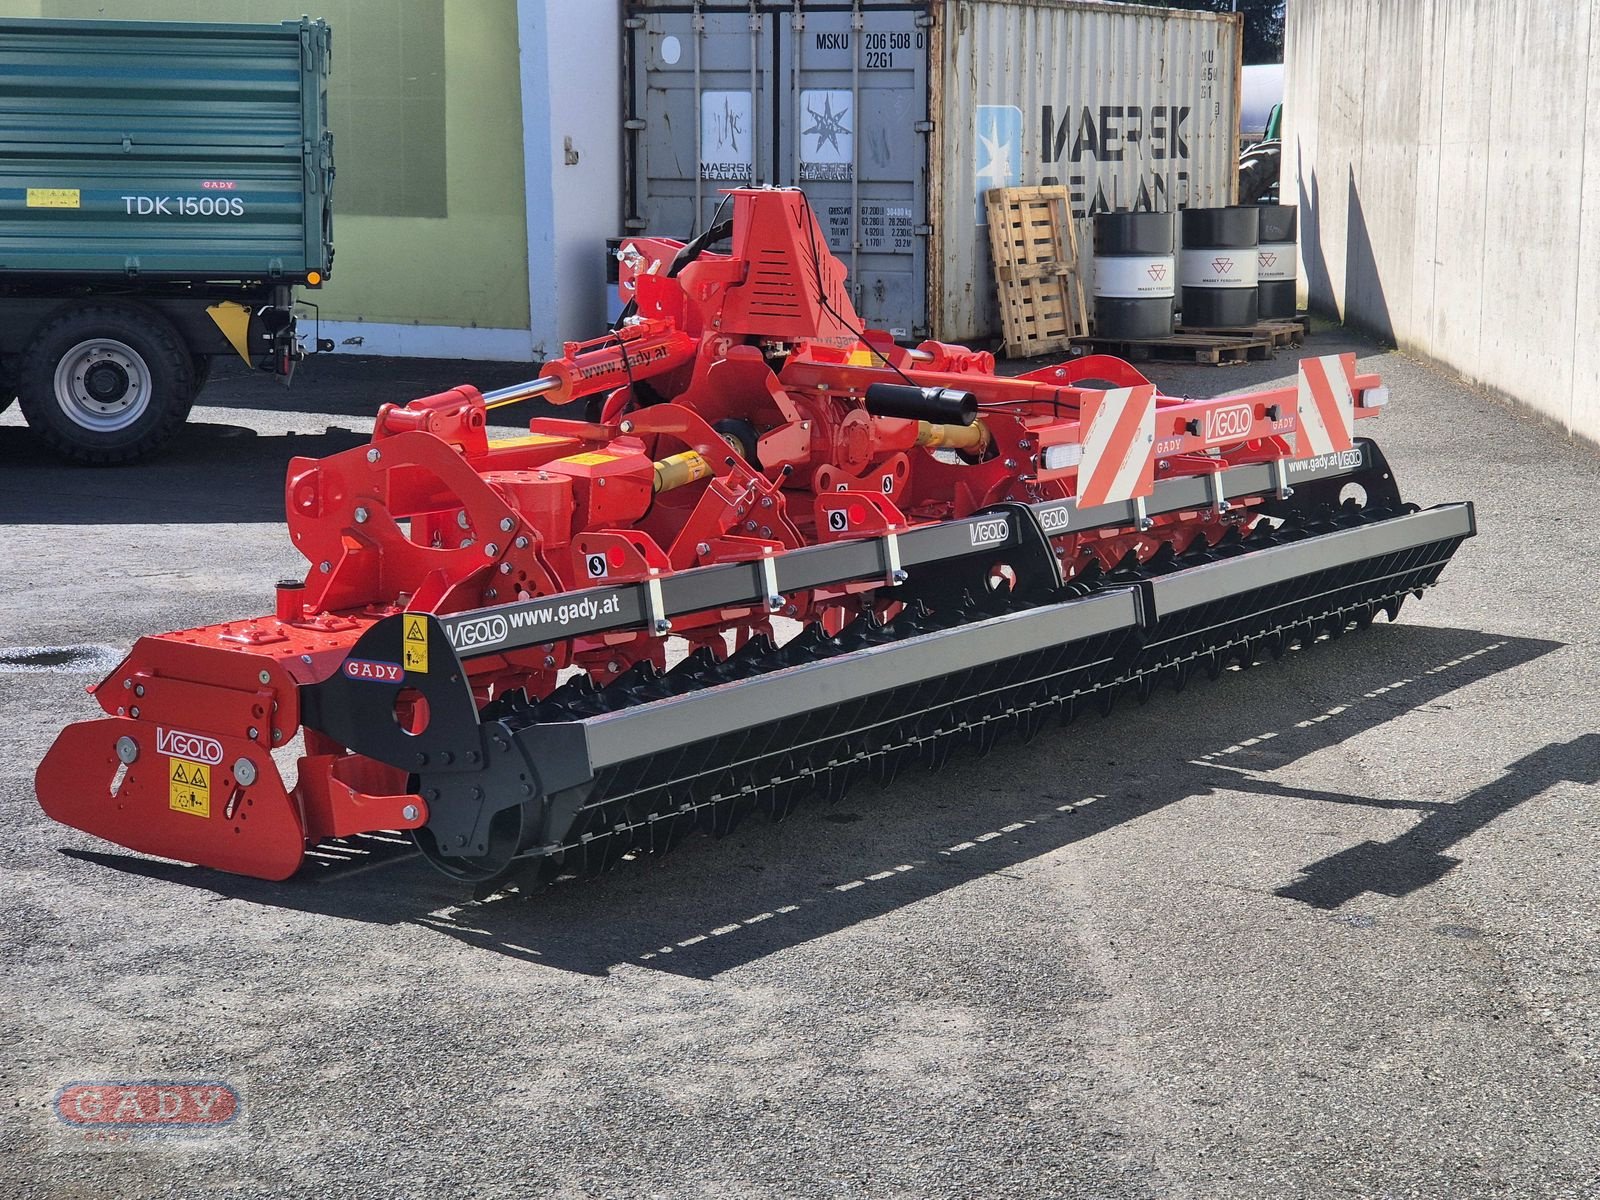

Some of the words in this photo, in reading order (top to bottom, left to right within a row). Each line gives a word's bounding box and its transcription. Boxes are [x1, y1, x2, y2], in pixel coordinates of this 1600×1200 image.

[816, 33, 849, 50] MSKU
[865, 33, 887, 50] 206
[890, 33, 911, 50] 508
[916, 32, 923, 49] 0
[866, 52, 893, 68] 22G1
[1041, 104, 1191, 163] MAERSK
[700, 162, 753, 173] MAERSK
[203, 181, 233, 190] GADY
[1041, 172, 1190, 219] EALAND
[121, 196, 173, 216] TDK
[177, 197, 245, 216] 1500S
[582, 344, 668, 379] www.gady.at
[1206, 403, 1253, 444] VIGOLO
[1272, 417, 1294, 430] GADY
[1156, 438, 1182, 454] GADY
[1288, 453, 1338, 472] www.gady.at
[969, 518, 1009, 546] VIGOLO
[446, 614, 508, 651] VIGOLO
[509, 594, 620, 629] www.gady.at
[348, 662, 398, 680] GADY
[156, 726, 224, 766] VIGOLO
